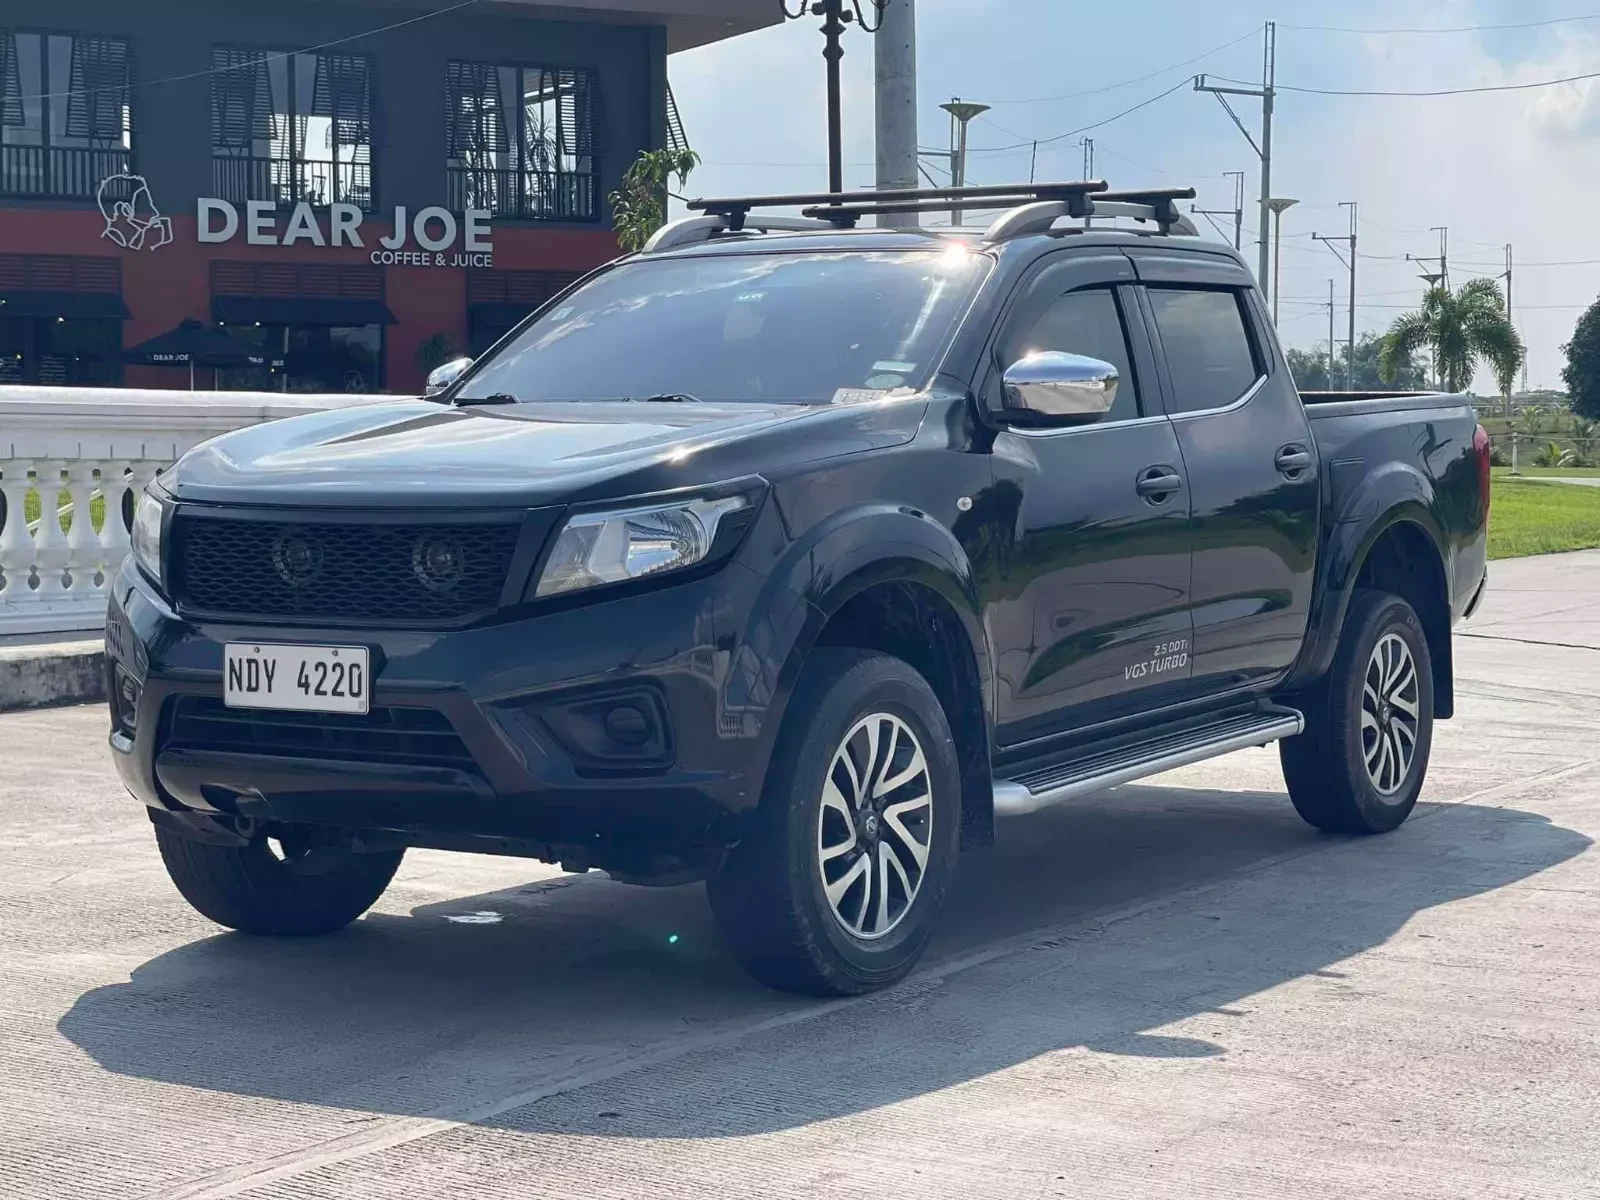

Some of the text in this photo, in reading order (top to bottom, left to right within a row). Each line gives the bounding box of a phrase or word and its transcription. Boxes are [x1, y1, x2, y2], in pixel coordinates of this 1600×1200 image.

[197, 197, 494, 252] DEAR JOE
[370, 251, 493, 268] COFFEE & JUICE
[229, 657, 362, 698] NDY 4220
[1124, 653, 1187, 680] VGS TURBO
